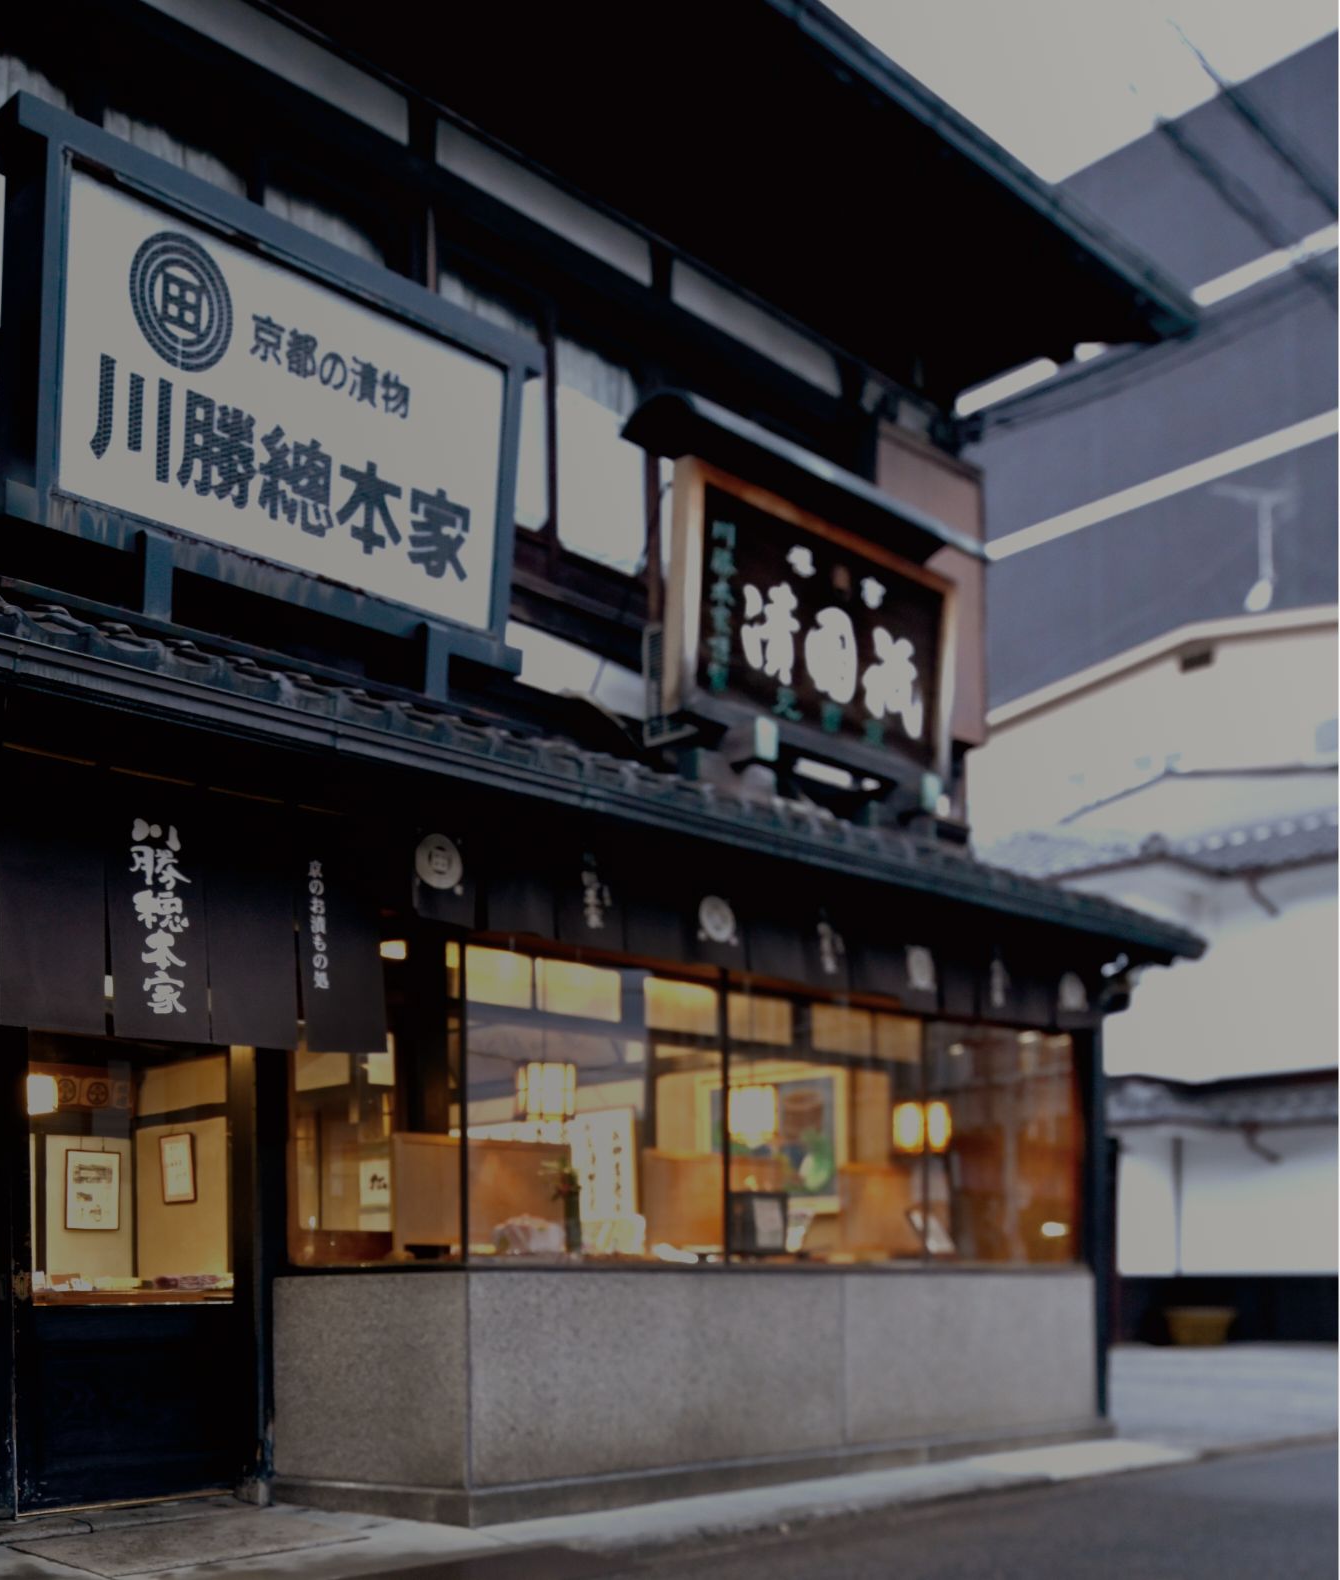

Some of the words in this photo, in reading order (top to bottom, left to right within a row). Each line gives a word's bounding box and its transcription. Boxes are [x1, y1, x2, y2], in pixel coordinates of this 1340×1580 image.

[251, 314, 410, 420] 京都の漬物
